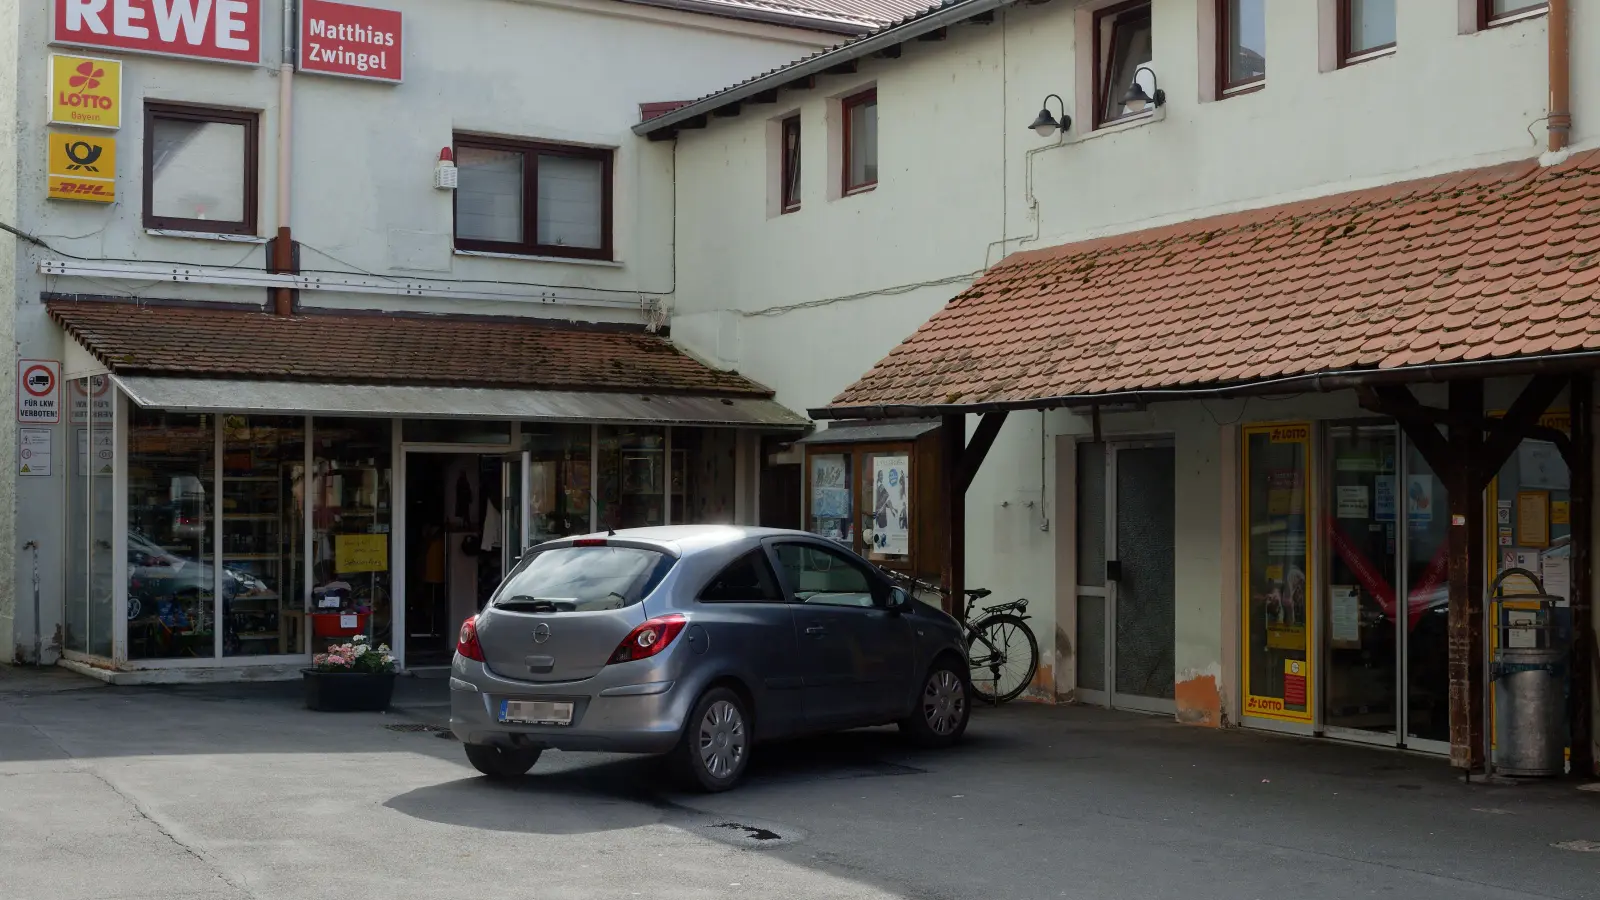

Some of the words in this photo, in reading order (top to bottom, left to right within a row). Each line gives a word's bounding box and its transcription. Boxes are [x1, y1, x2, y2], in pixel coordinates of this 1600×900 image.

[65, 0, 250, 51] REWE
[309, 18, 394, 46] Matthias
[309, 42, 386, 71] Zwingel
[60, 91, 112, 110] LOTTO
[71, 111, 100, 121] Bayern
[59, 182, 107, 196] DHL
[24, 399, 38, 407] FÜR
[20, 409, 58, 418] VERBOTEN!
[1281, 428, 1307, 439] LOTTO
[1258, 699, 1282, 711] LOTTO
